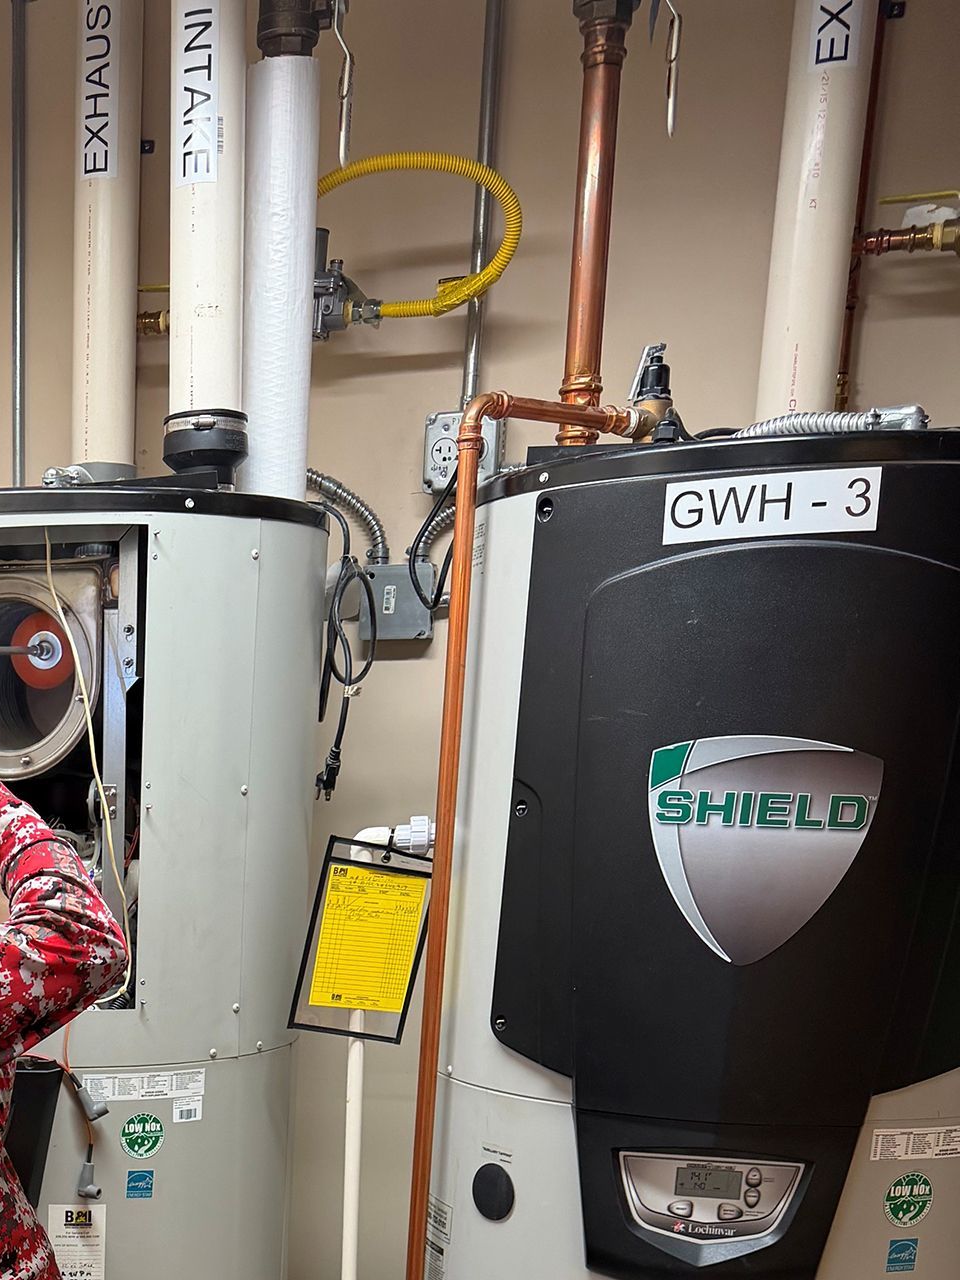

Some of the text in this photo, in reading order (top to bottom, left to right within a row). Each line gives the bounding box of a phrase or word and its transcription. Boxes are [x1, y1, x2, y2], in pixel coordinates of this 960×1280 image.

[84, 0, 112, 174] EXHAUS
[183, 9, 212, 177] INTAKE
[671, 482, 792, 528] GWH
[845, 478, 872, 518] 3
[655, 789, 869, 830] SHIELD
[125, 1123, 143, 1133] LOW
[890, 1185, 911, 1197] LOW
[688, 1224, 737, 1236] Lochinvar
